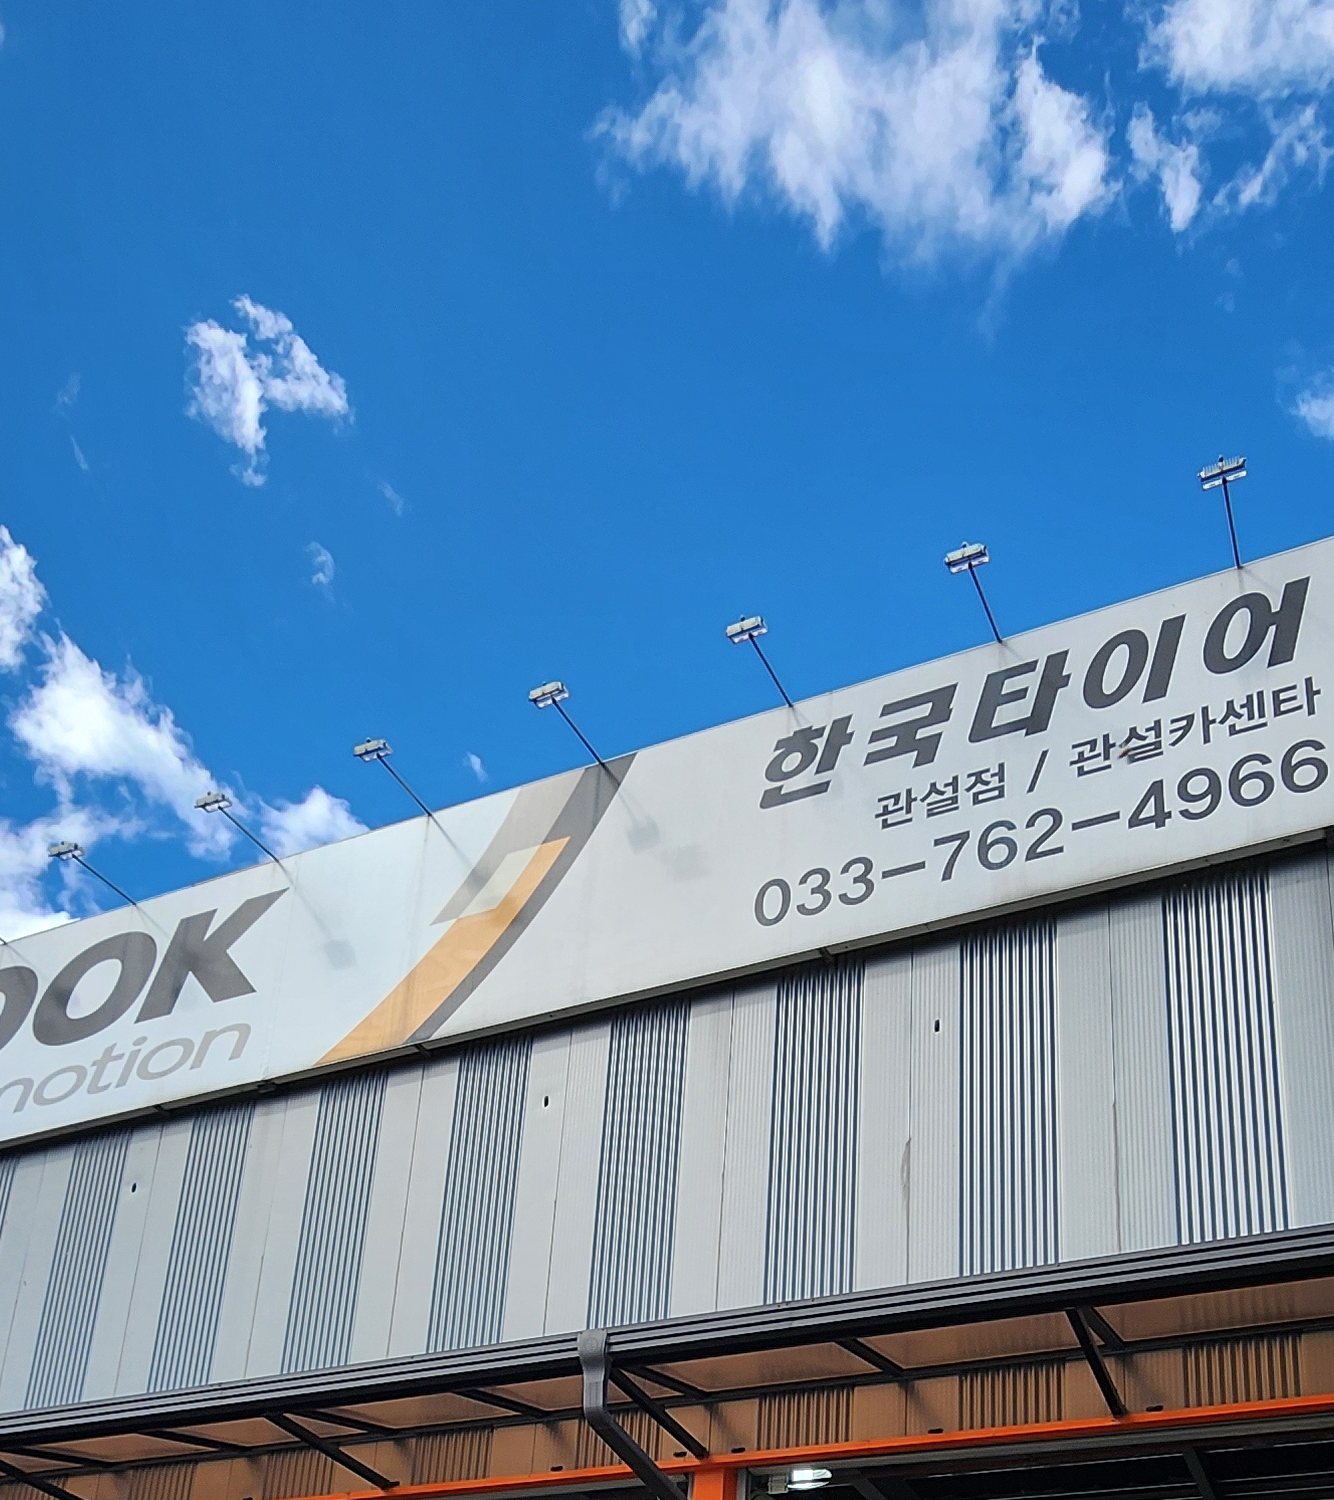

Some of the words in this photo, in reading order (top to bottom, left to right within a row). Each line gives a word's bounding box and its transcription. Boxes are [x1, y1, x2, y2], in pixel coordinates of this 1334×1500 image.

[759, 575, 1312, 810] 한국타이어
[874, 762, 1009, 830] 관설점
[1069, 676, 1322, 778] 관설카센타
[753, 738, 1330, 928] 033-762-4966
